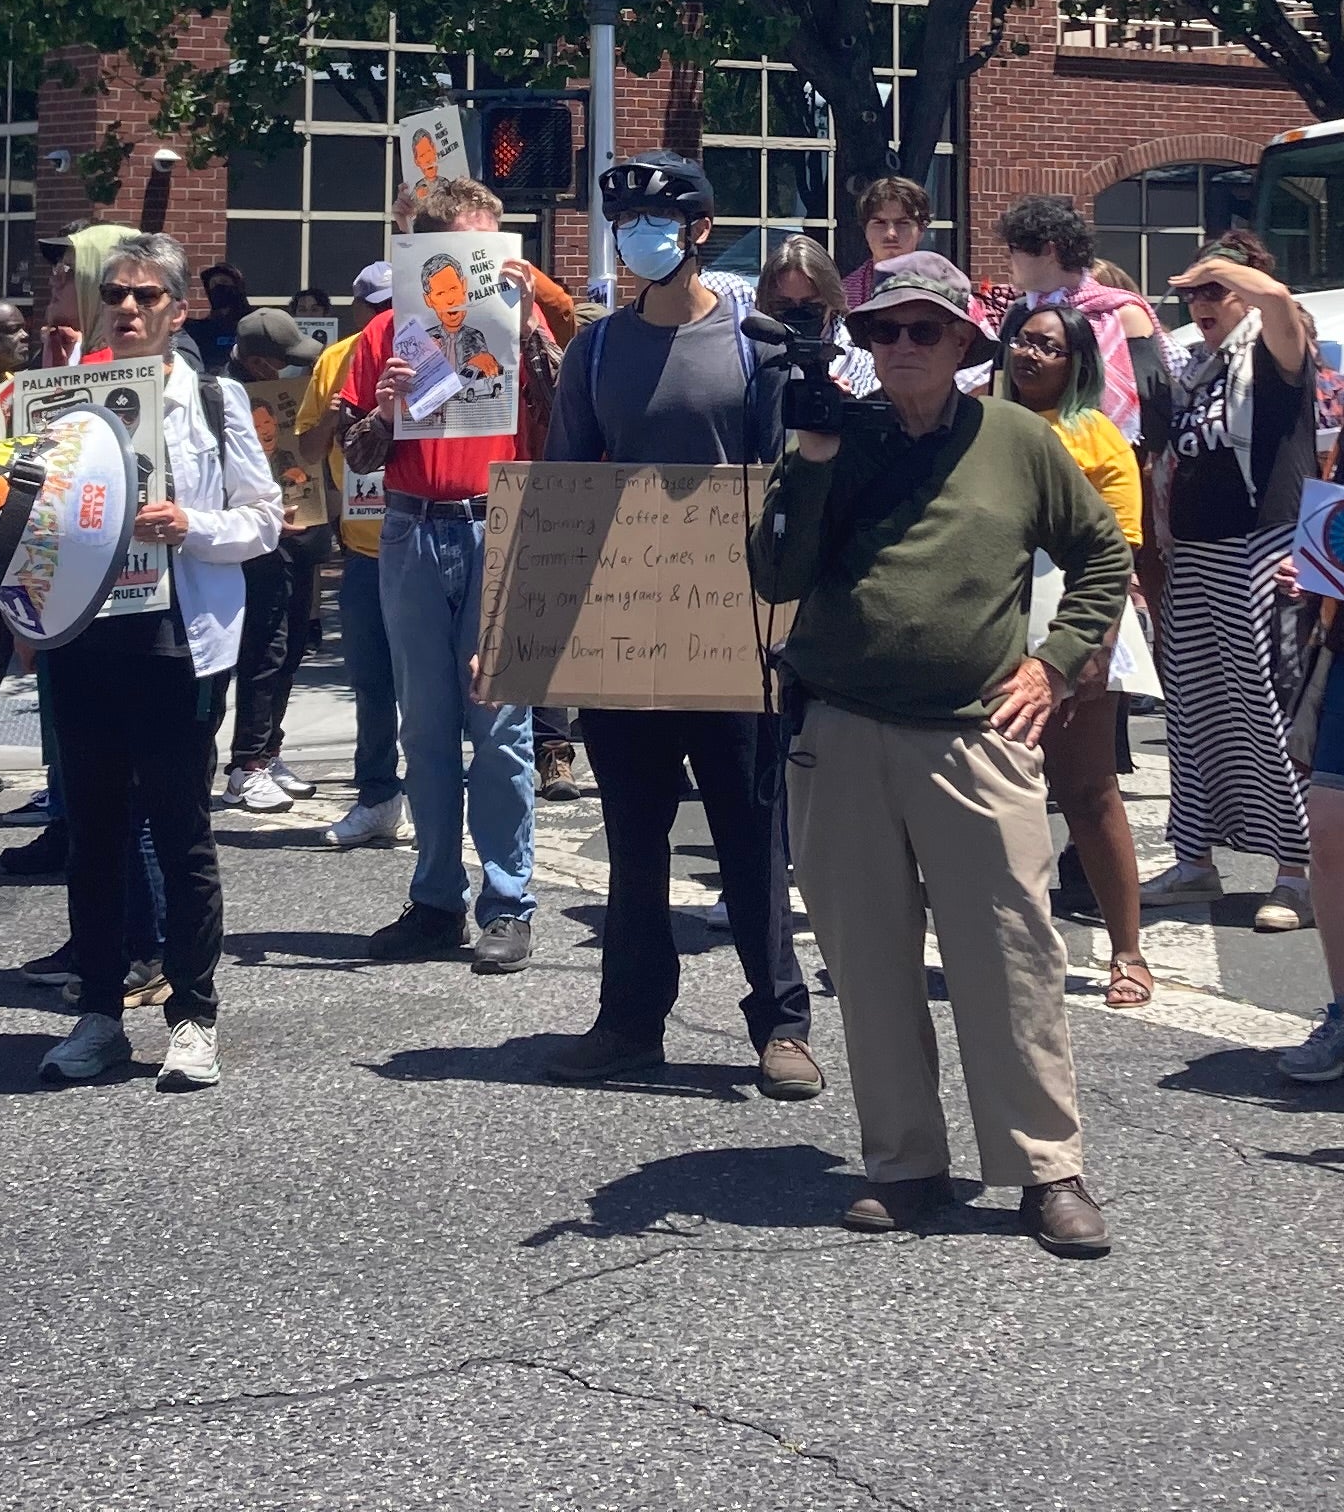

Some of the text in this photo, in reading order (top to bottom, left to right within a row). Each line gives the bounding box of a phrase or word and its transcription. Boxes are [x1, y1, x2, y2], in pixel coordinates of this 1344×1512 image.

[472, 249, 487, 261] ICE
[470, 260, 495, 275] RUNS
[479, 273, 492, 285] ON
[468, 281, 512, 301] PALANTIR
[22, 366, 155, 391] PALANTIR POWERS ICE
[615, 507, 670, 526] Coffee
[683, 505, 699, 524] &
[599, 546, 632, 568] War
[643, 545, 694, 568] Crimes
[705, 552, 715, 563] in
[514, 582, 546, 618] Spy
[670, 584, 680, 602] &
[610, 636, 667, 663] Team
